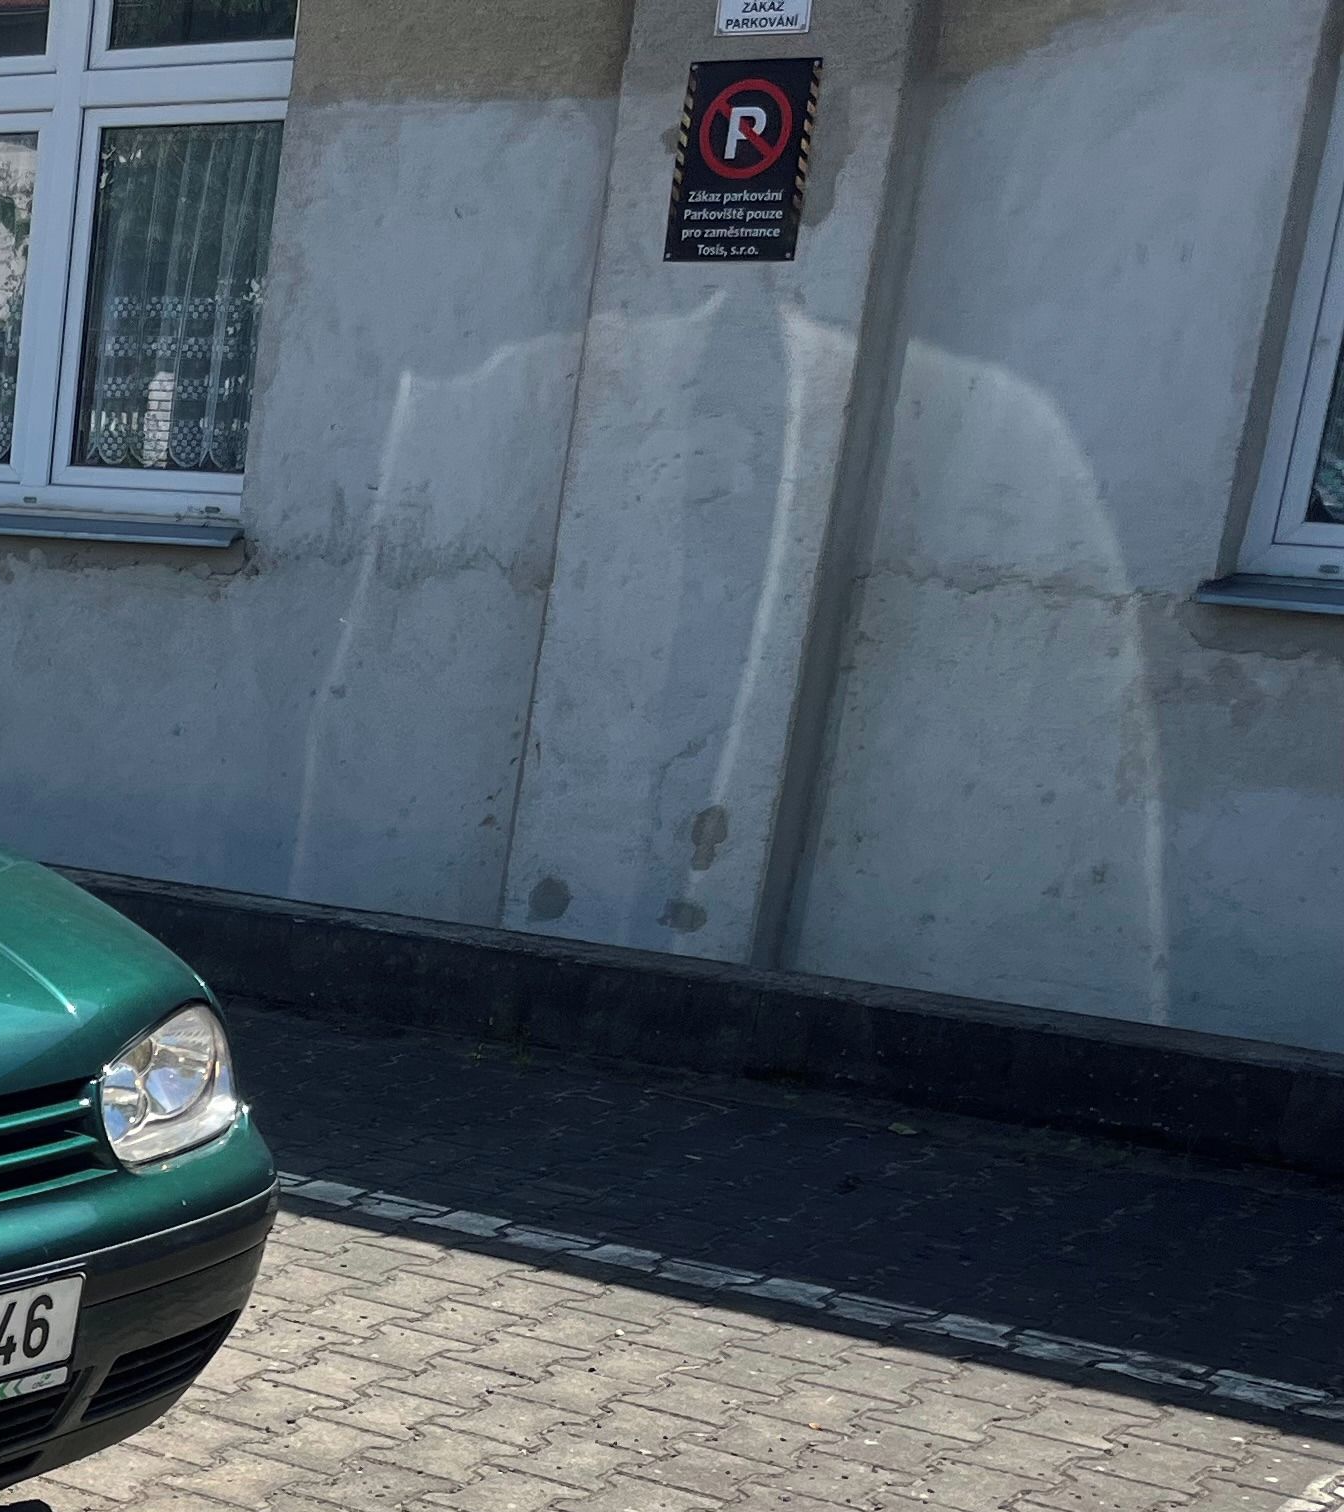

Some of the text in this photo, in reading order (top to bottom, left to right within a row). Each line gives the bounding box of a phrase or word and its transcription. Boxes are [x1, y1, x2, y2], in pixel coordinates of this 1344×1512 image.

[725, 14, 798, 29] PARKOVÁNÍ
[723, 106, 767, 160] P
[688, 188, 784, 205] Zákaz parkování
[684, 207, 784, 222] Parkoviště pouze
[681, 225, 781, 241] pro zaměstnance
[730, 246, 759, 256] s.r.o.
